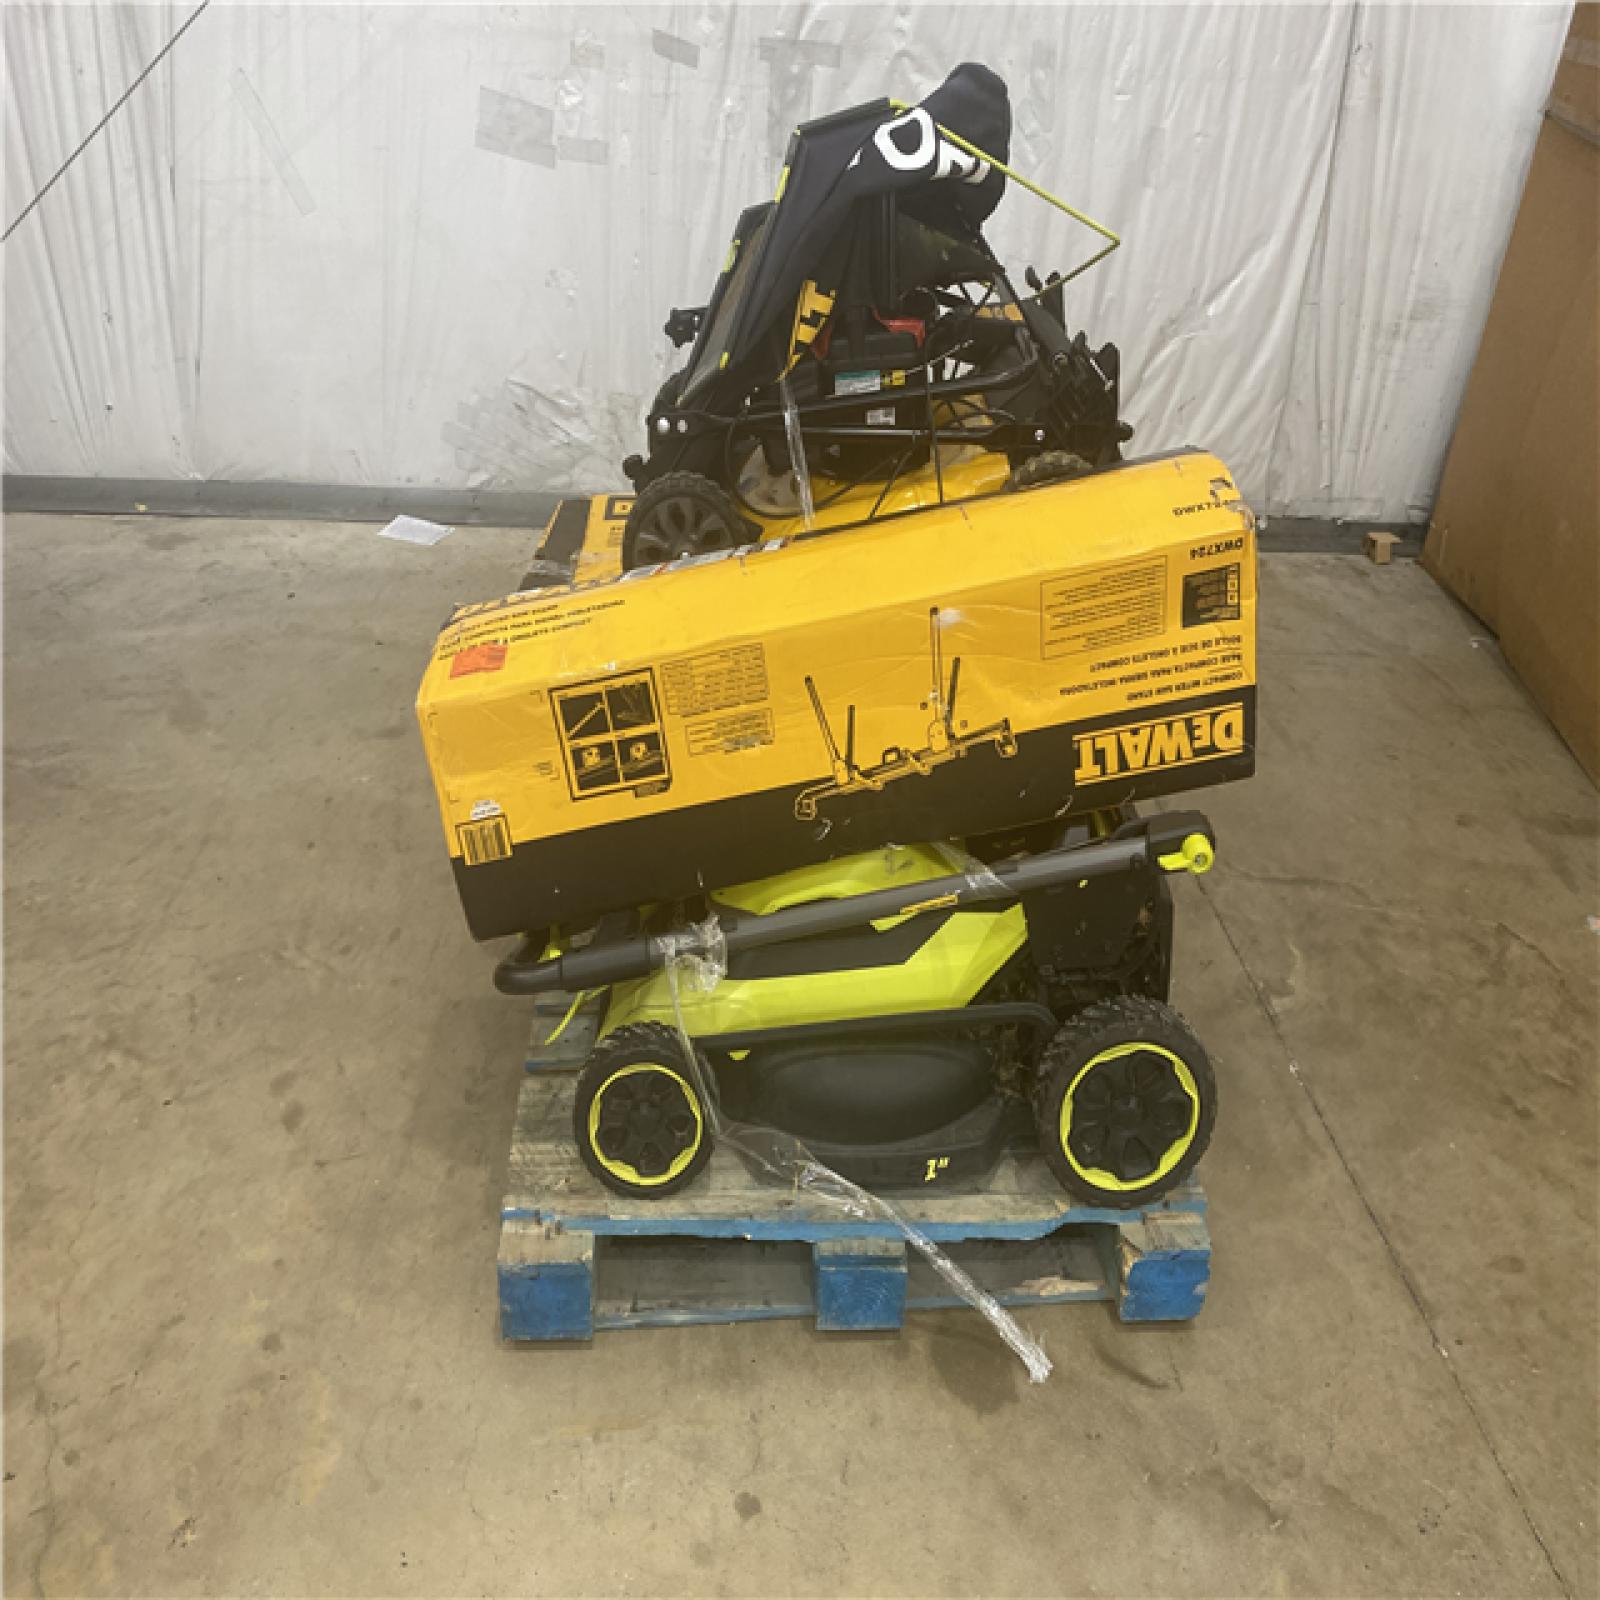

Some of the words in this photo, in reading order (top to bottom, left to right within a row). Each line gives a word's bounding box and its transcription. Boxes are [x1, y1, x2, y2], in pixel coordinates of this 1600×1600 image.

[1190, 537, 1243, 560] DWX724
[1174, 679, 1201, 692] MITER
[1201, 670, 1243, 686] COMPACT
